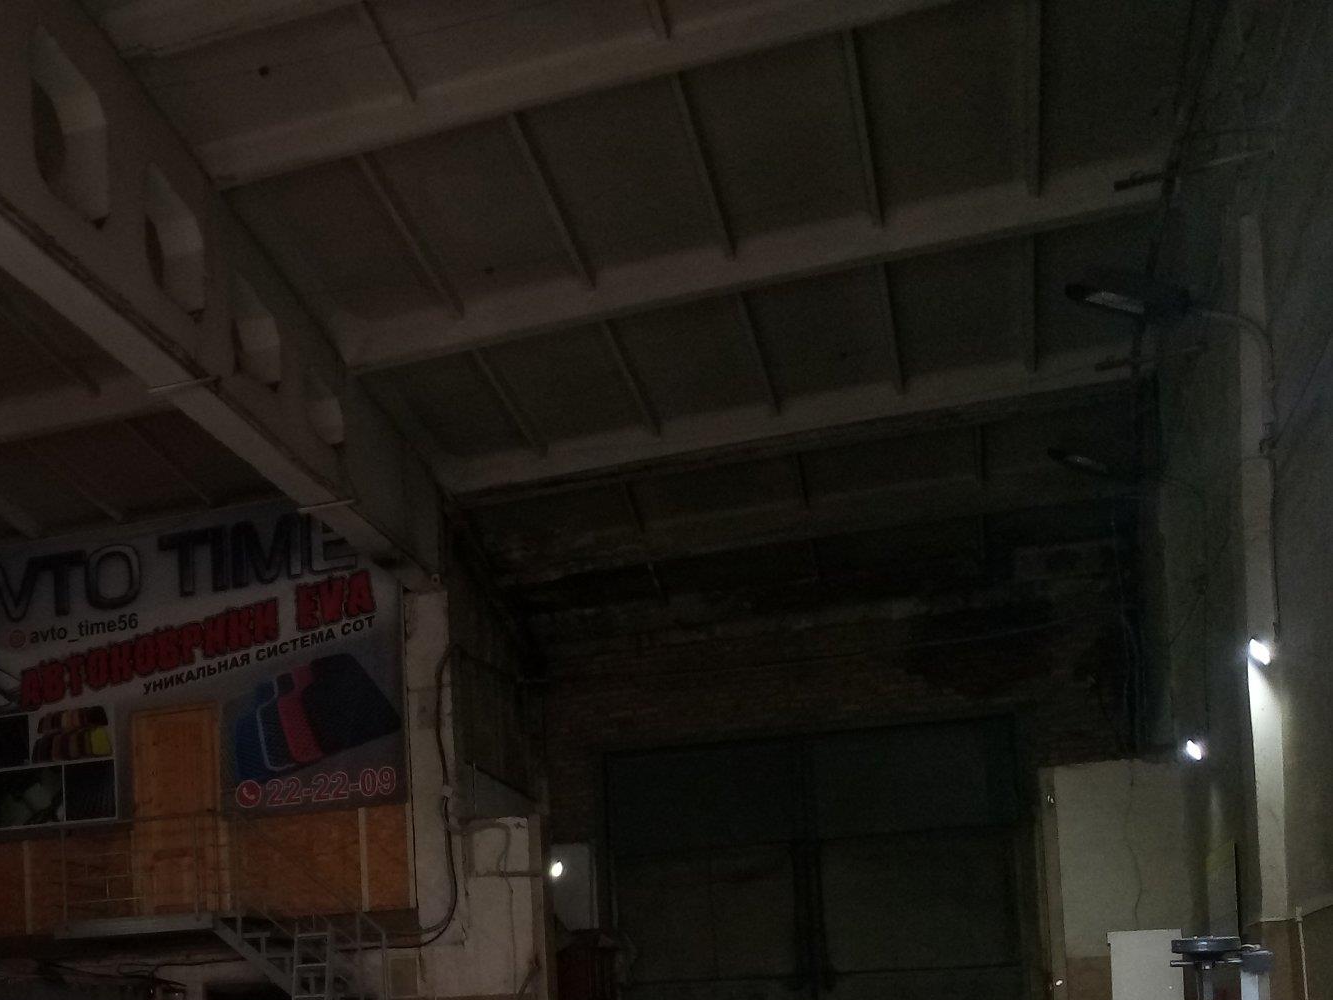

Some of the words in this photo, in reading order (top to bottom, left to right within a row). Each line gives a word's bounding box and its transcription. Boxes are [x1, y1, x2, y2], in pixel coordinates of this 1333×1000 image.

[158, 512, 357, 597] TIME
[21, 599, 279, 711] АВТОКОВРИКИ
[29, 612, 140, 645] avto_time56
[143, 653, 251, 695] УНИКАЛЬНАЯ
[256, 629, 336, 662] СИСТЕМА
[341, 616, 376, 637] СОТ
[266, 766, 397, 807] 22-22-09
